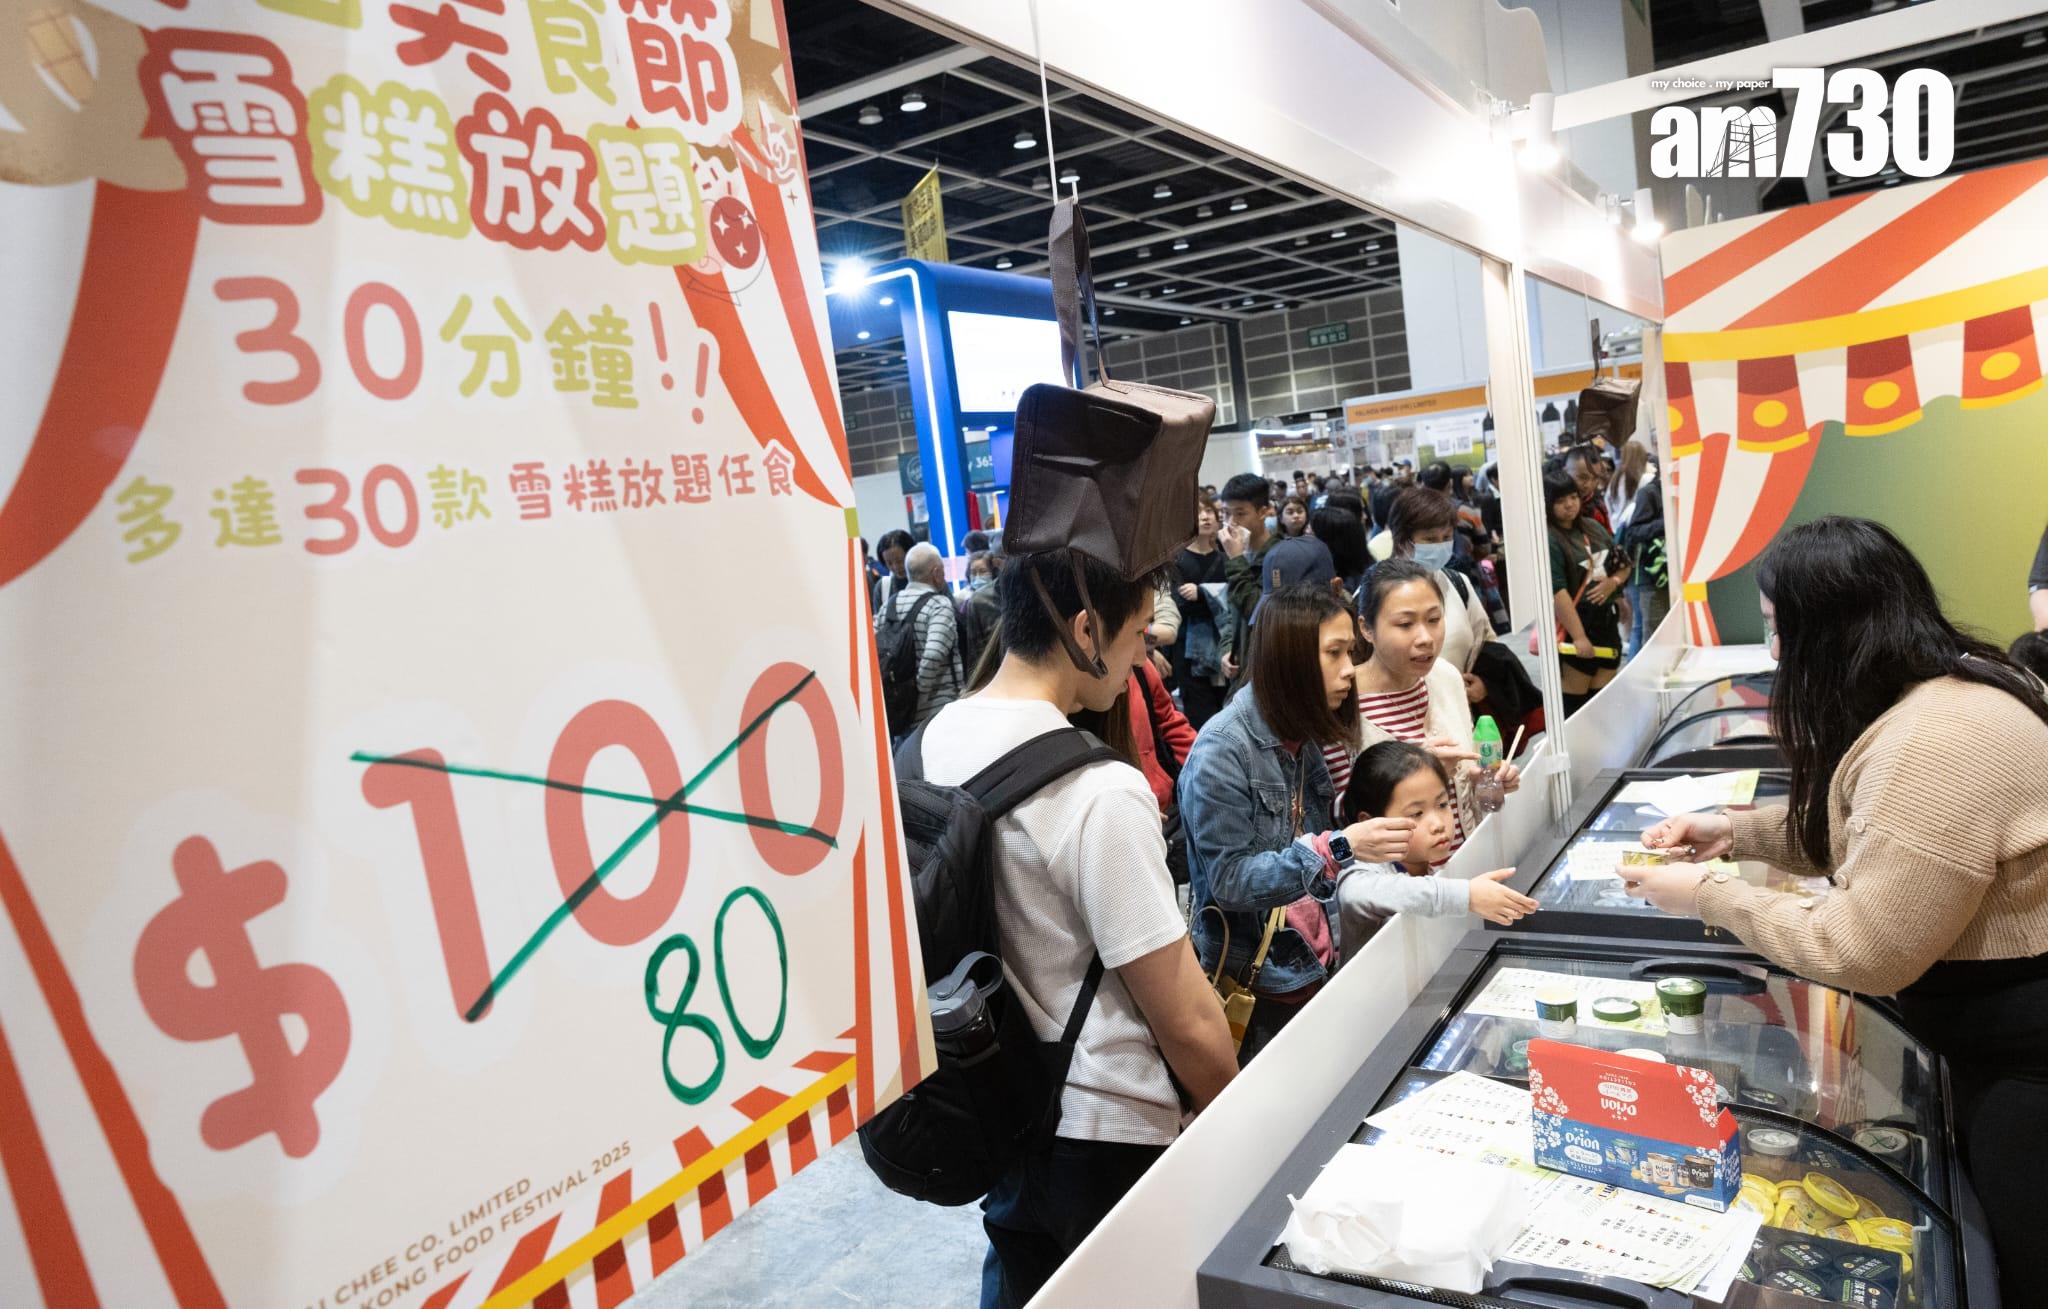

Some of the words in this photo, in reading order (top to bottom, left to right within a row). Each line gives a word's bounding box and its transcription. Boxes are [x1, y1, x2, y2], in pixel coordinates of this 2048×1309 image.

[155, 40, 700, 260] 雪糕放題
[644, 886, 788, 1105] 80
[1565, 1131, 1600, 1151] Orion
[1600, 1097, 1638, 1116] Orion
[335, 1255, 398, 1305] CHEE
[405, 1234, 443, 1263] CO.
[449, 1178, 531, 1237] LIMITED
[433, 1226, 494, 1274] FOOD
[500, 1172, 588, 1233] FESTIVAL
[592, 1140, 632, 1176] 2025
